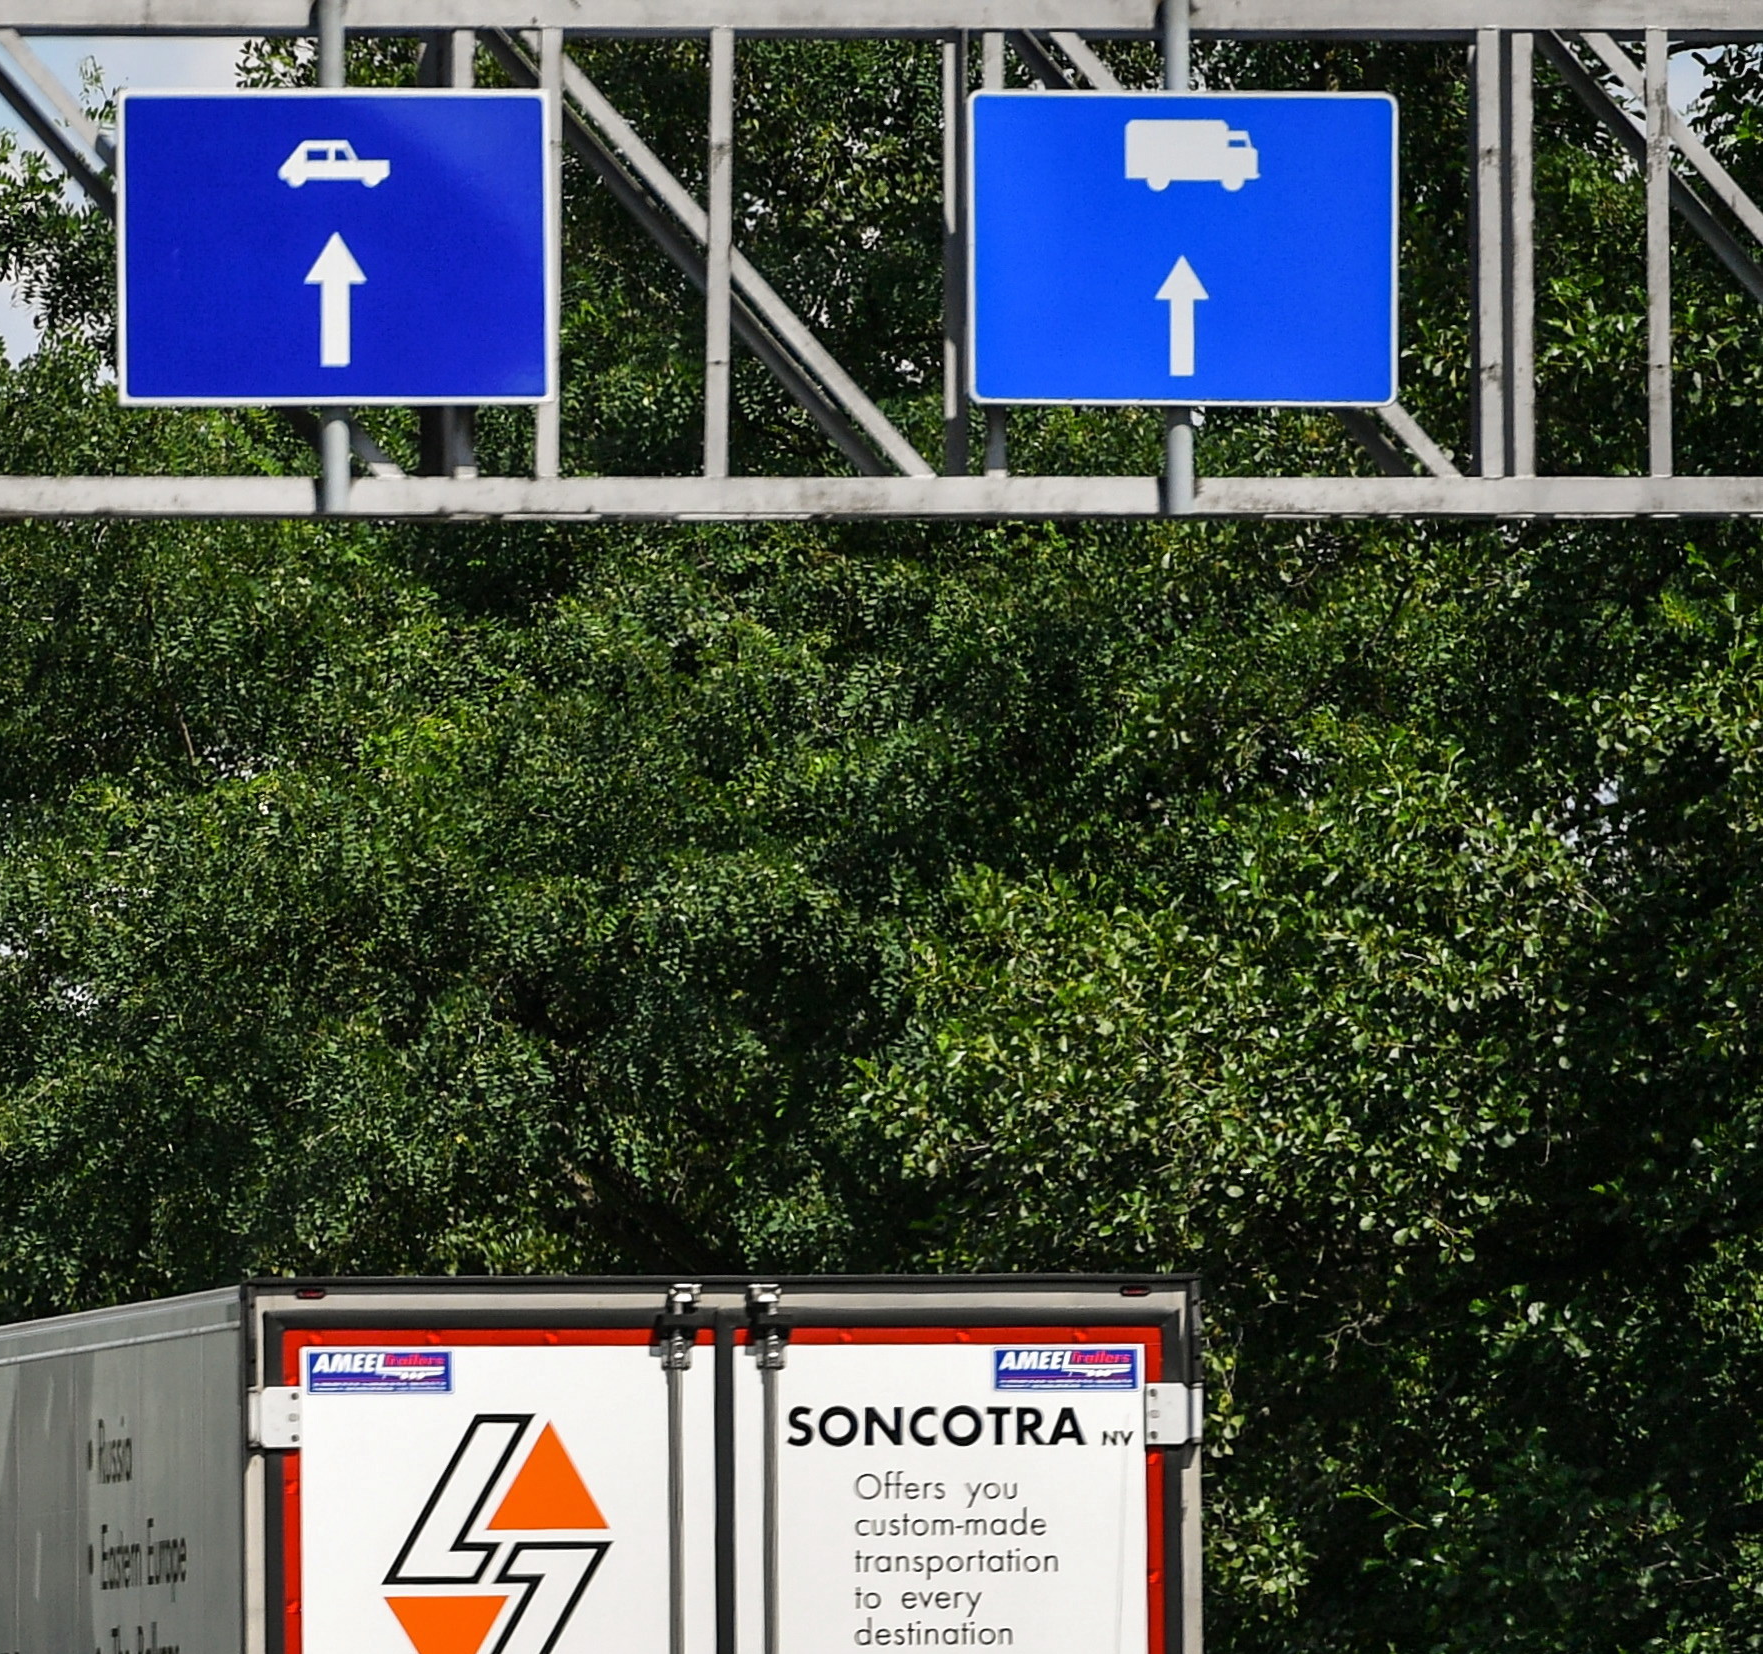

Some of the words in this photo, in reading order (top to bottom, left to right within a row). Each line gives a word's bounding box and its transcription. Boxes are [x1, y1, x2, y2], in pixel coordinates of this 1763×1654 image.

[312, 1353, 386, 1374] AMEEL
[998, 1350, 1072, 1371] AMEEL
[787, 1405, 1087, 1448] SONCOTRA
[1101, 1430, 1134, 1447] NV
[97, 1415, 133, 1484] Russia
[855, 1470, 946, 1501] Offers
[966, 1482, 1018, 1509] you
[854, 1507, 1047, 1537] custom-made
[100, 1524, 143, 1590] Eastern
[146, 1518, 187, 1602] Europe
[854, 1547, 1059, 1580] transportation
[854, 1586, 882, 1610] to
[900, 1591, 983, 1618] every
[854, 1616, 1013, 1646] destination
